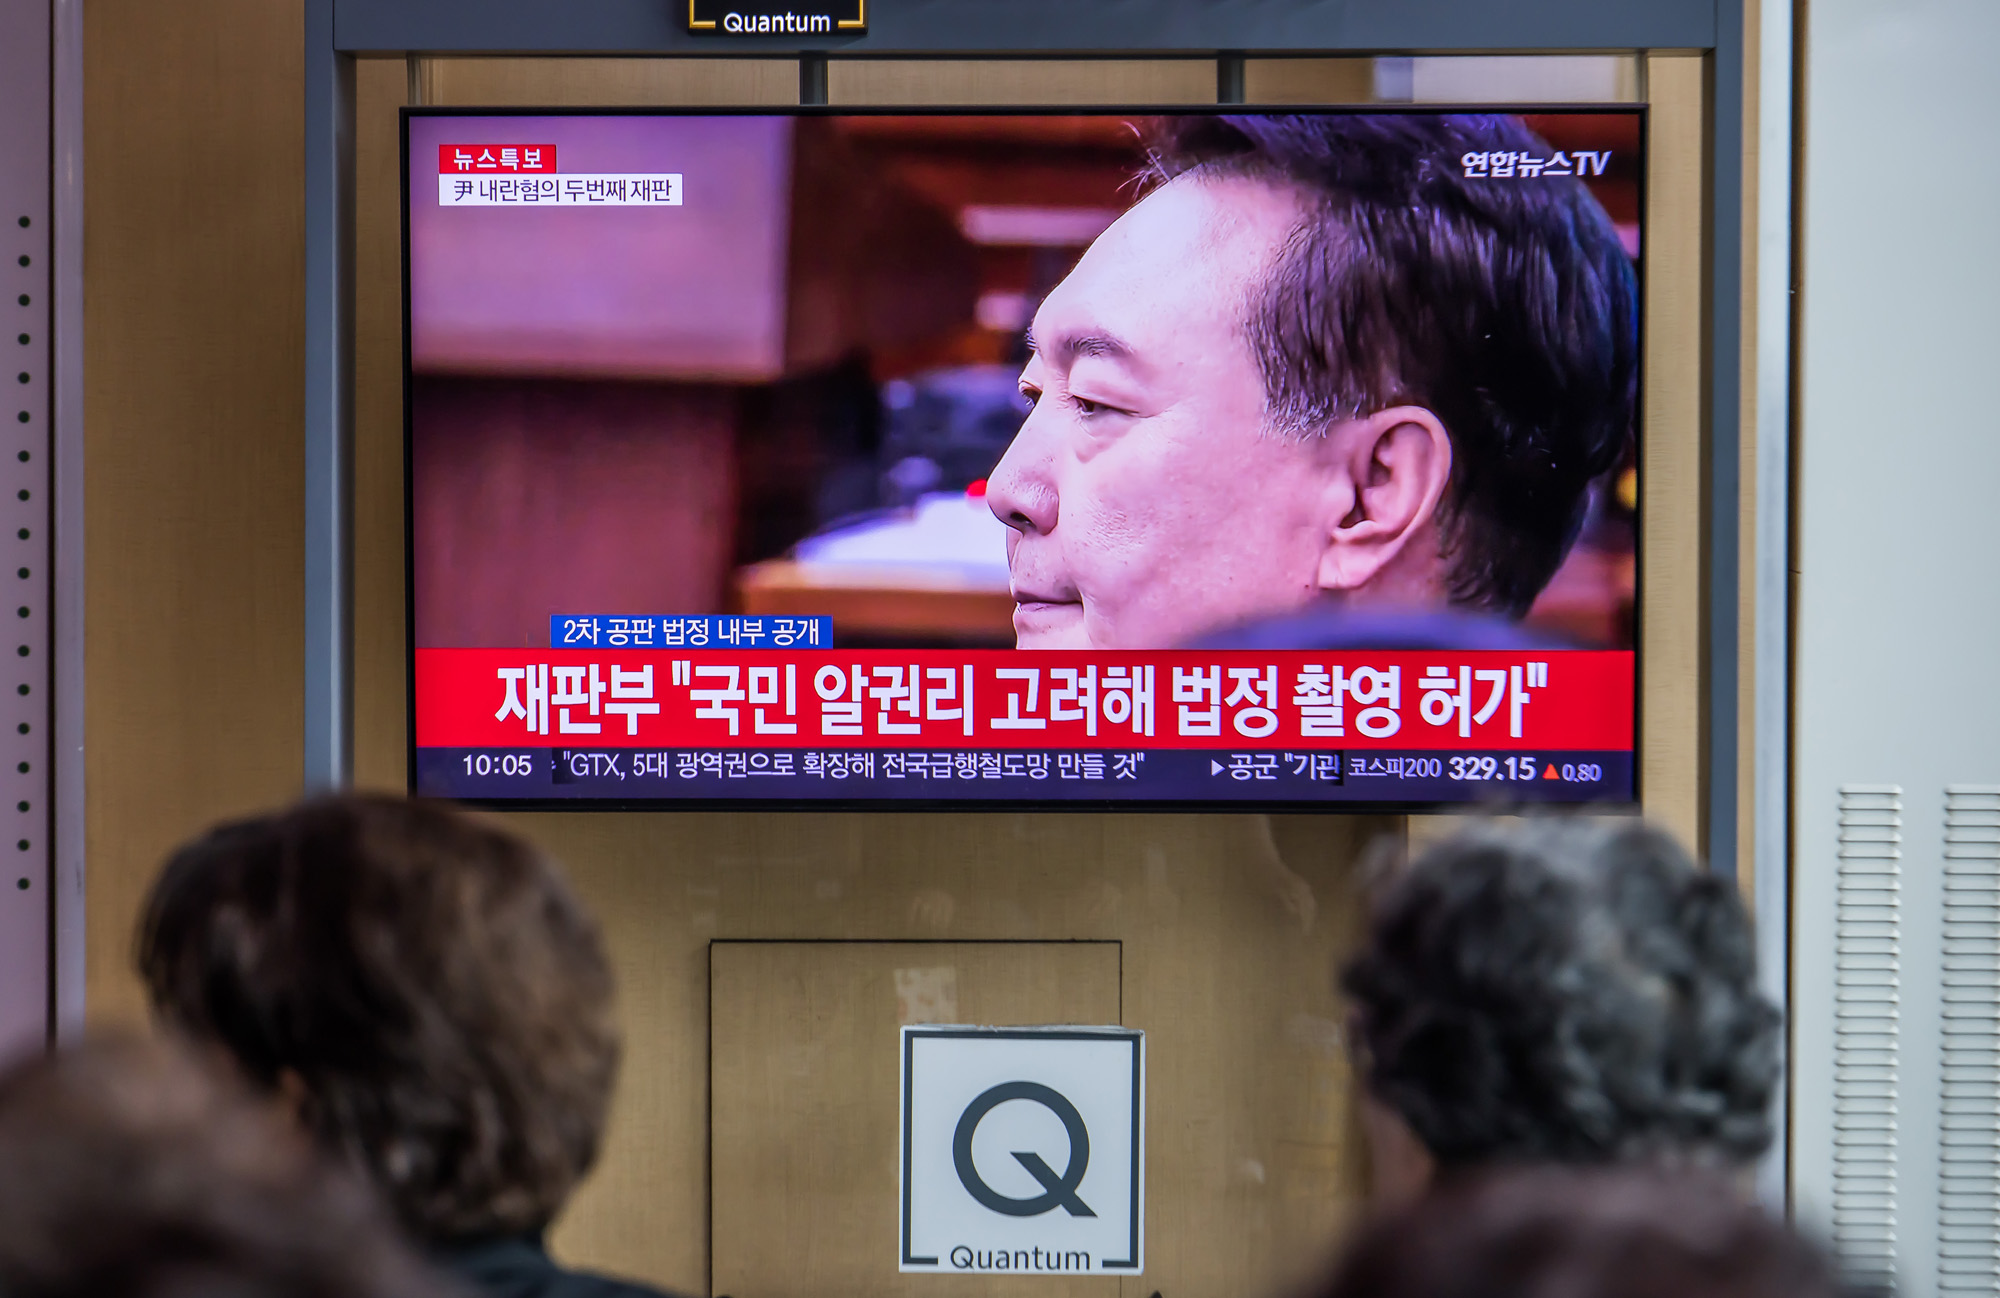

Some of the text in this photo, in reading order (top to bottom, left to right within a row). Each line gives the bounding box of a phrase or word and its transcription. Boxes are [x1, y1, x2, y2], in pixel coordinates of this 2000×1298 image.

[723, 11, 831, 33] Quantum
[453, 148, 543, 171] 뉴스특보
[1460, 150, 1613, 178] 연합뉴스TV
[453, 179, 672, 202] 尹 내란혐의 두번째 재판
[563, 618, 820, 646] 2차 공판 법정 내부 공개
[494, 660, 1549, 739] 재판부 "국민 알권리 고려해 법정 촬영 허가"
[463, 754, 533, 776] 10:05
[632, 752, 668, 779] 5대
[675, 752, 797, 779] 광역권으로
[803, 752, 875, 779] 확장해
[882, 752, 1052, 780] 전국급행철도망
[1057, 752, 1107, 780] 만들
[1112, 752, 1145, 780] 것"
[1228, 753, 1280, 781] 공군
[1348, 756, 1603, 783] 코스피200 329.15 0.80
[952, 1080, 1098, 1218] Q
[950, 1244, 1091, 1271] Quantum
